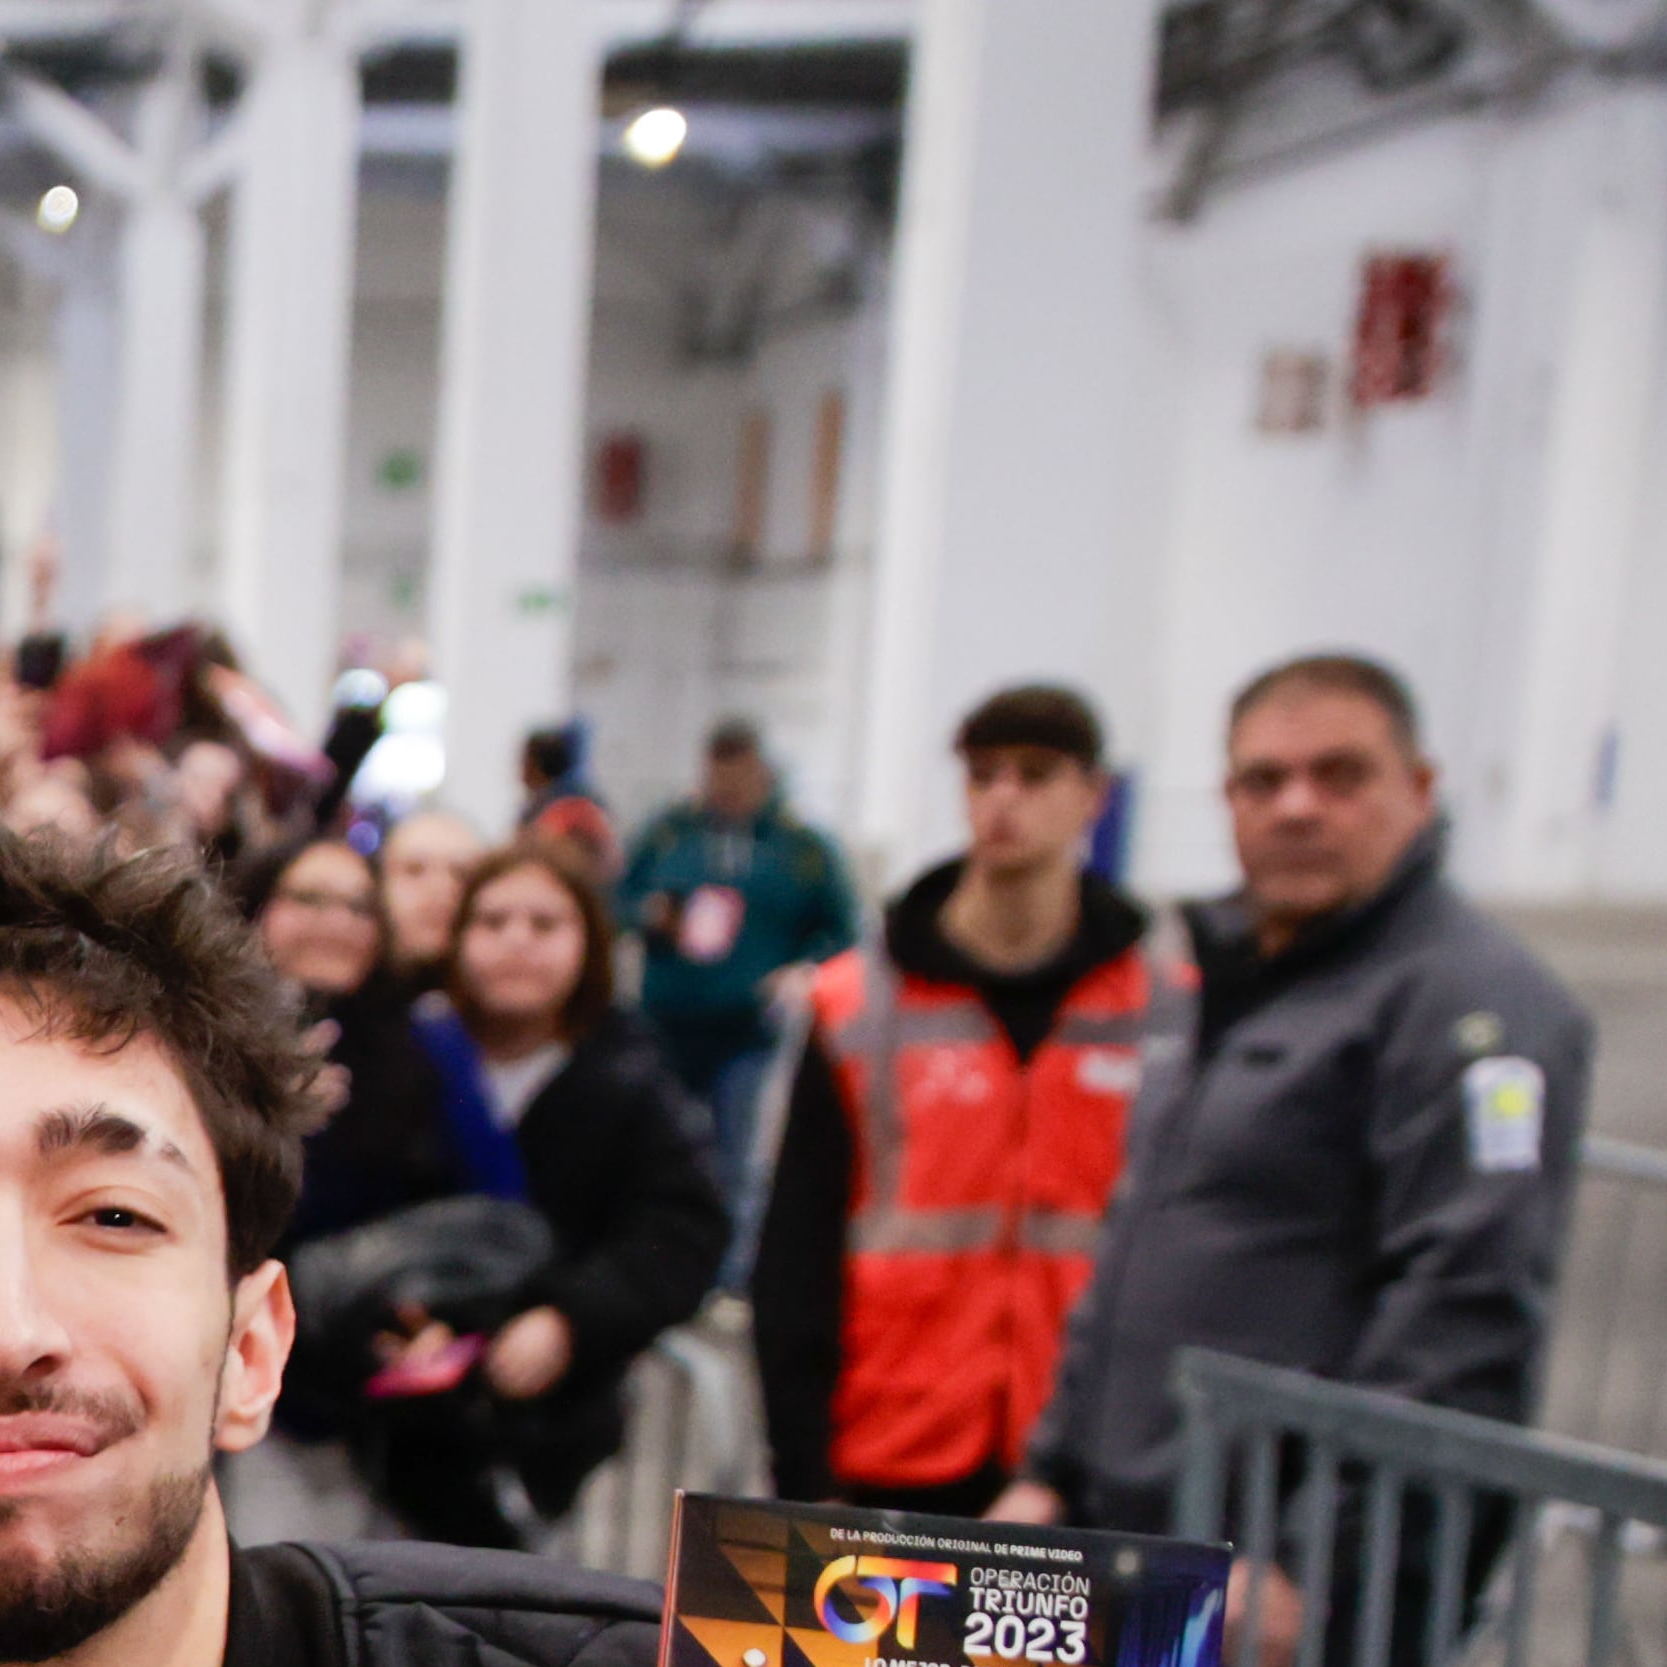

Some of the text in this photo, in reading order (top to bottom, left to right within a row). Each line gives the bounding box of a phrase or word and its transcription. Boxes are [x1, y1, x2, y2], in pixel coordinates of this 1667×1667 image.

[830, 1528, 1083, 1561] DE LA PRODUCCIÓN ORIGINAL DE PRIME VIDEO
[970, 1566, 1091, 1595] OPERACIÓN
[814, 1554, 958, 1650] OT
[969, 1587, 1088, 1620] TRIUNFO
[963, 1612, 1087, 1665] 2023
